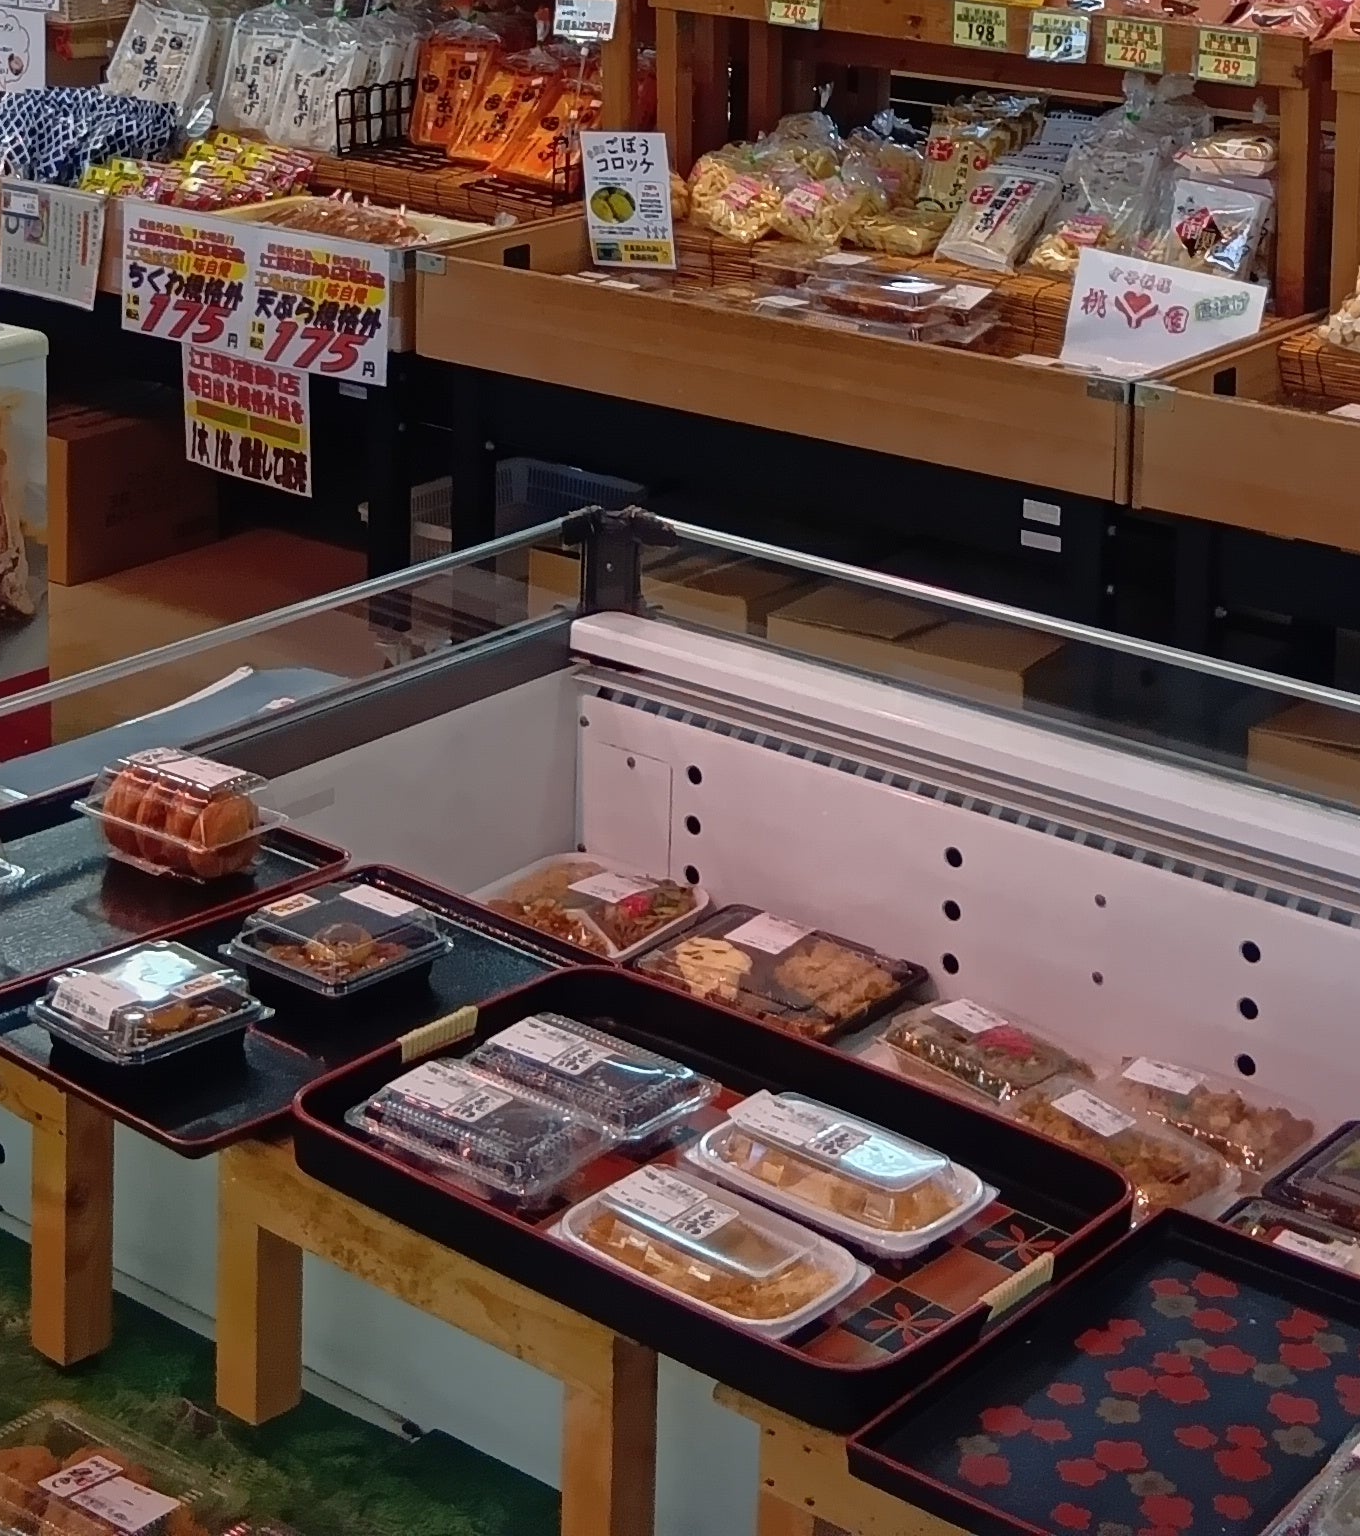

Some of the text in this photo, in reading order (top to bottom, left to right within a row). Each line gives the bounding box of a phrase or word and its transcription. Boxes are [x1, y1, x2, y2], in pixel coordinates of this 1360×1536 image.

[967, 24, 995, 42] 198
[1120, 47, 1147, 62] 220
[1214, 58, 1240, 75] 289
[606, 136, 649, 156] ごぼう
[597, 157, 654, 174] コロッケ
[129, 263, 243, 311] ちくわ規格外
[1082, 288, 1108, 318] 桃
[254, 289, 382, 338] 天ぷら規格外
